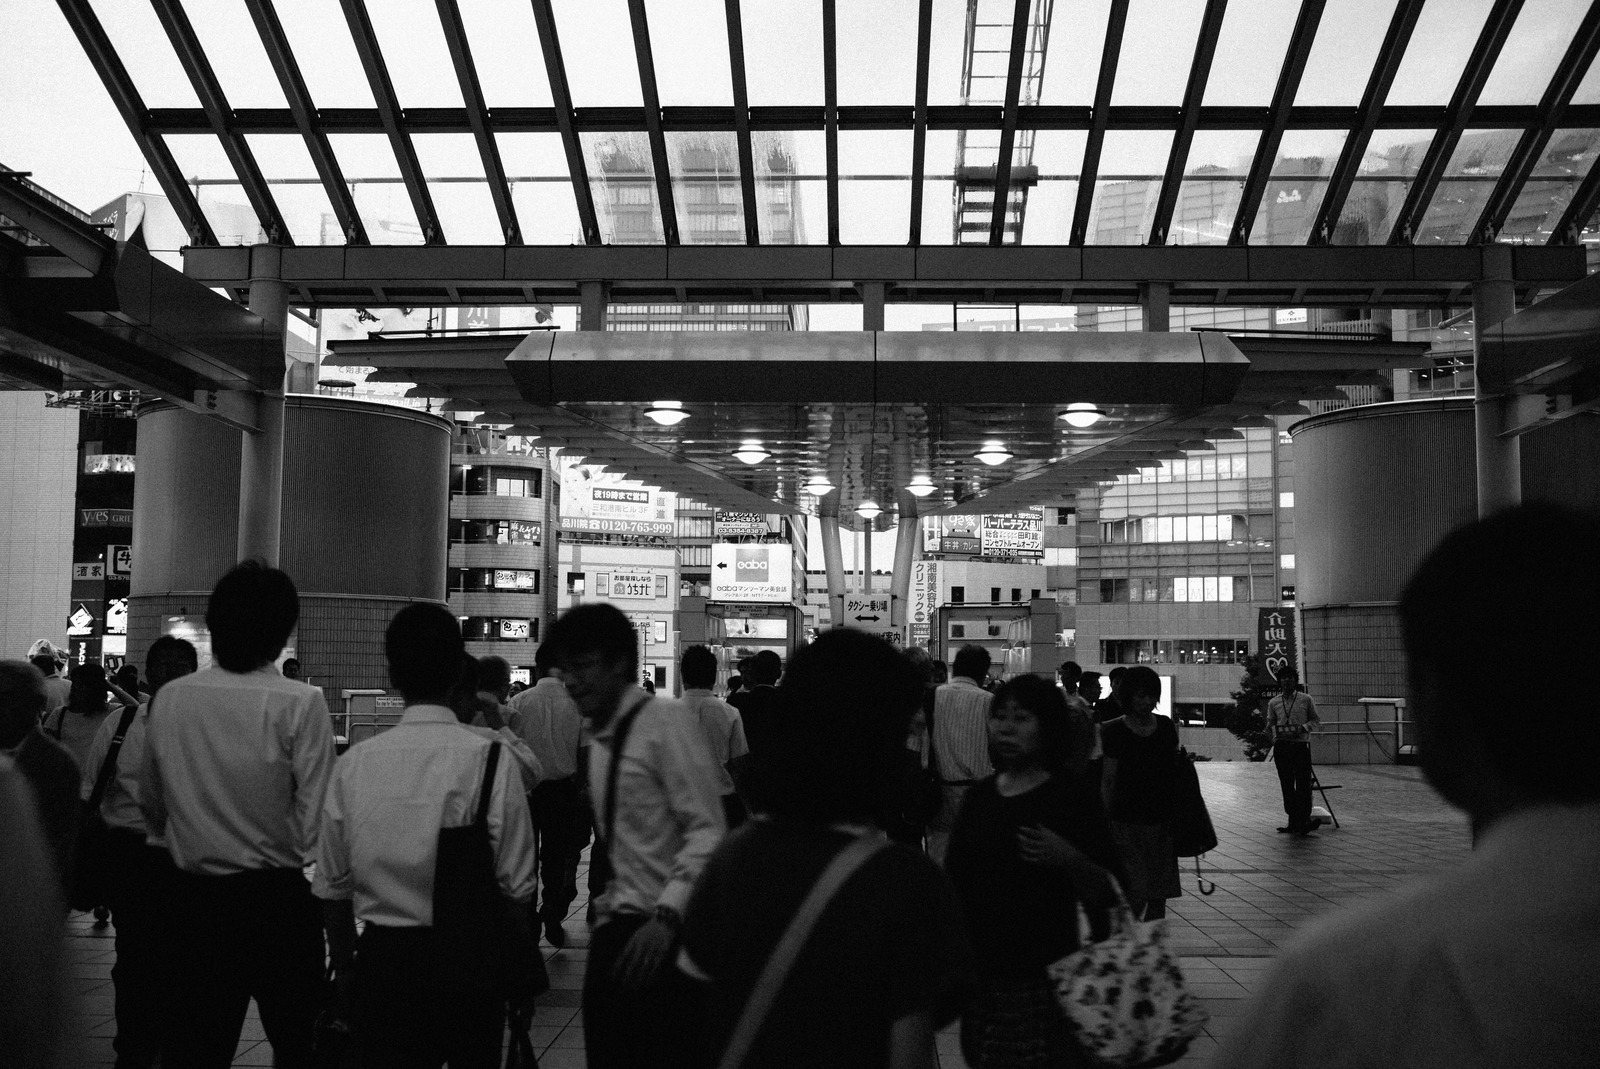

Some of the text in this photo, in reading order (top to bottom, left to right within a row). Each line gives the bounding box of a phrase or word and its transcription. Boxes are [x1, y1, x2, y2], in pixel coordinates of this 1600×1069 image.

[593, 490, 648, 501] 夜19時まで営業
[562, 519, 673, 534] 品川院 0120-765-999
[77, 566, 102, 577] 酒家
[915, 563, 925, 611] クリニック
[847, 600, 888, 612] タクシー乗り場
